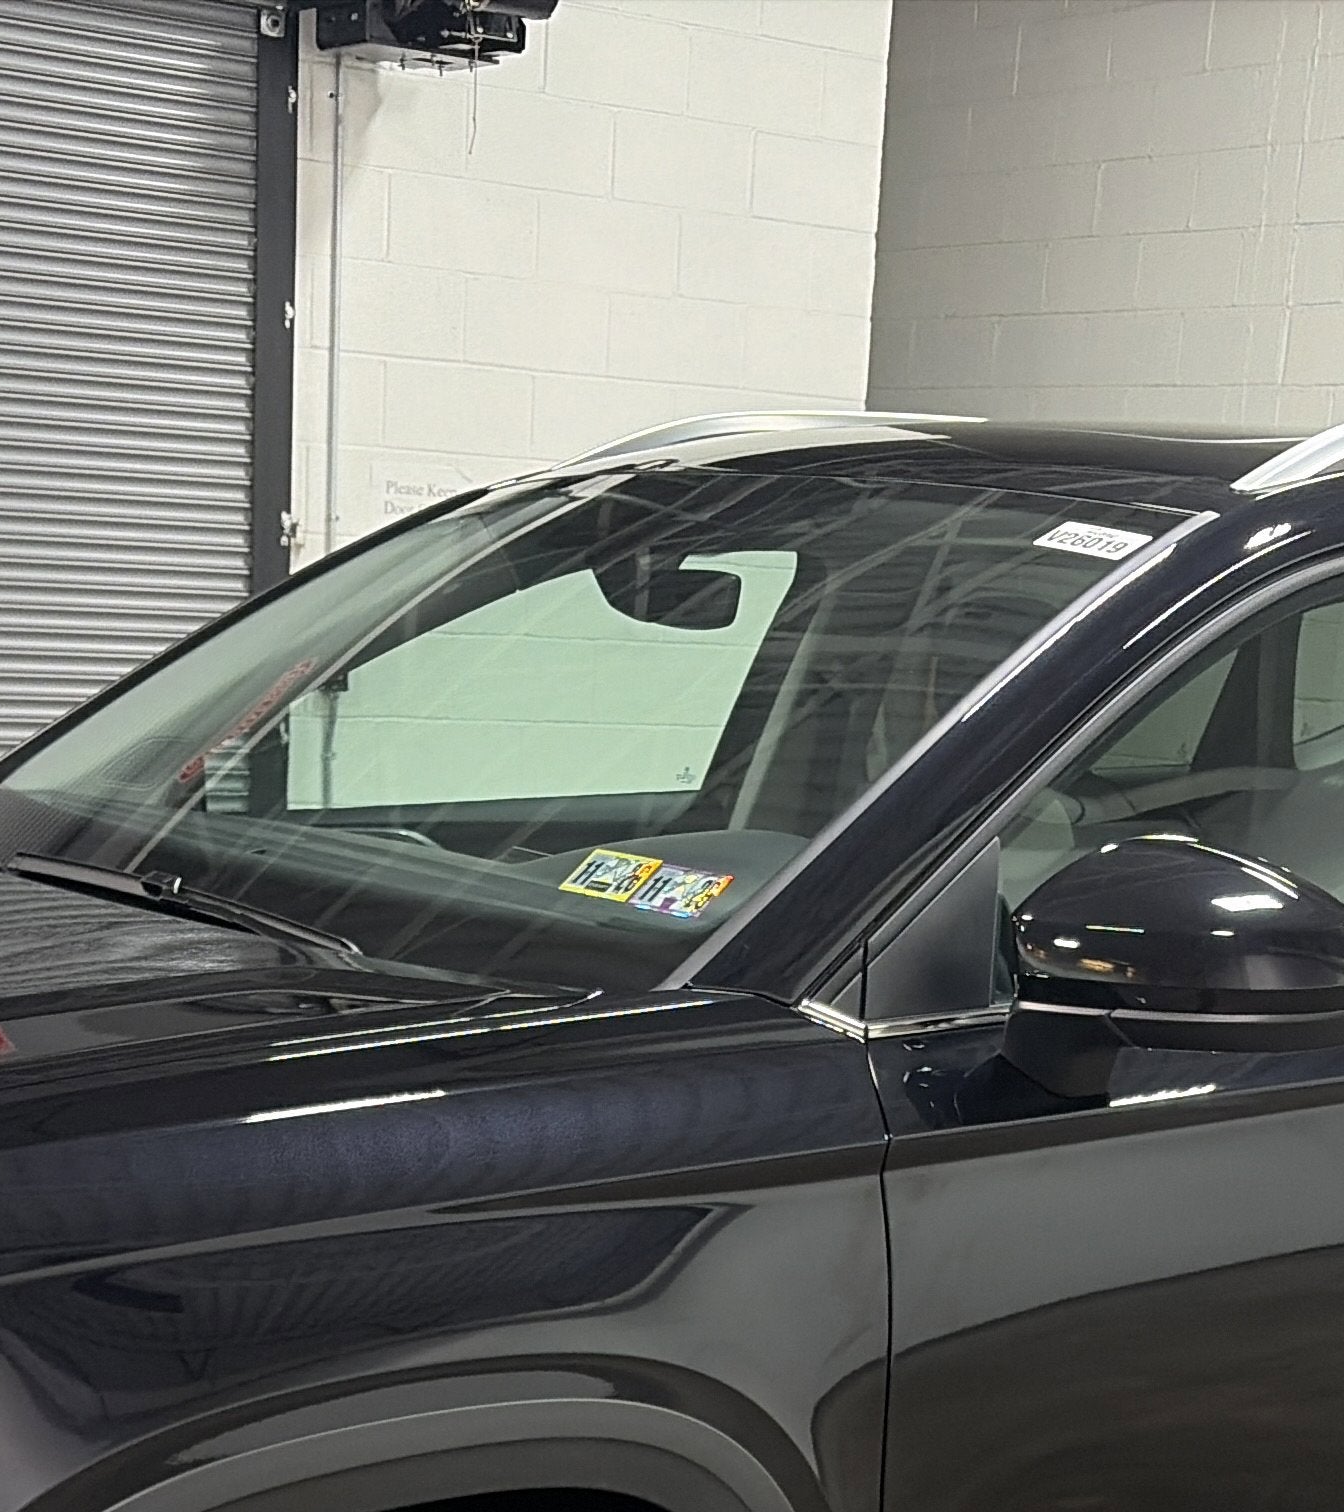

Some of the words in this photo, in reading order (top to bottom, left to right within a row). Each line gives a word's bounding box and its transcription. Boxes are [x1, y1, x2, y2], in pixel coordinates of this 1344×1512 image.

[386, 480, 424, 496] Please
[1047, 530, 1128, 553] V26019
[573, 860, 604, 885] 11
[640, 876, 672, 901] 11
